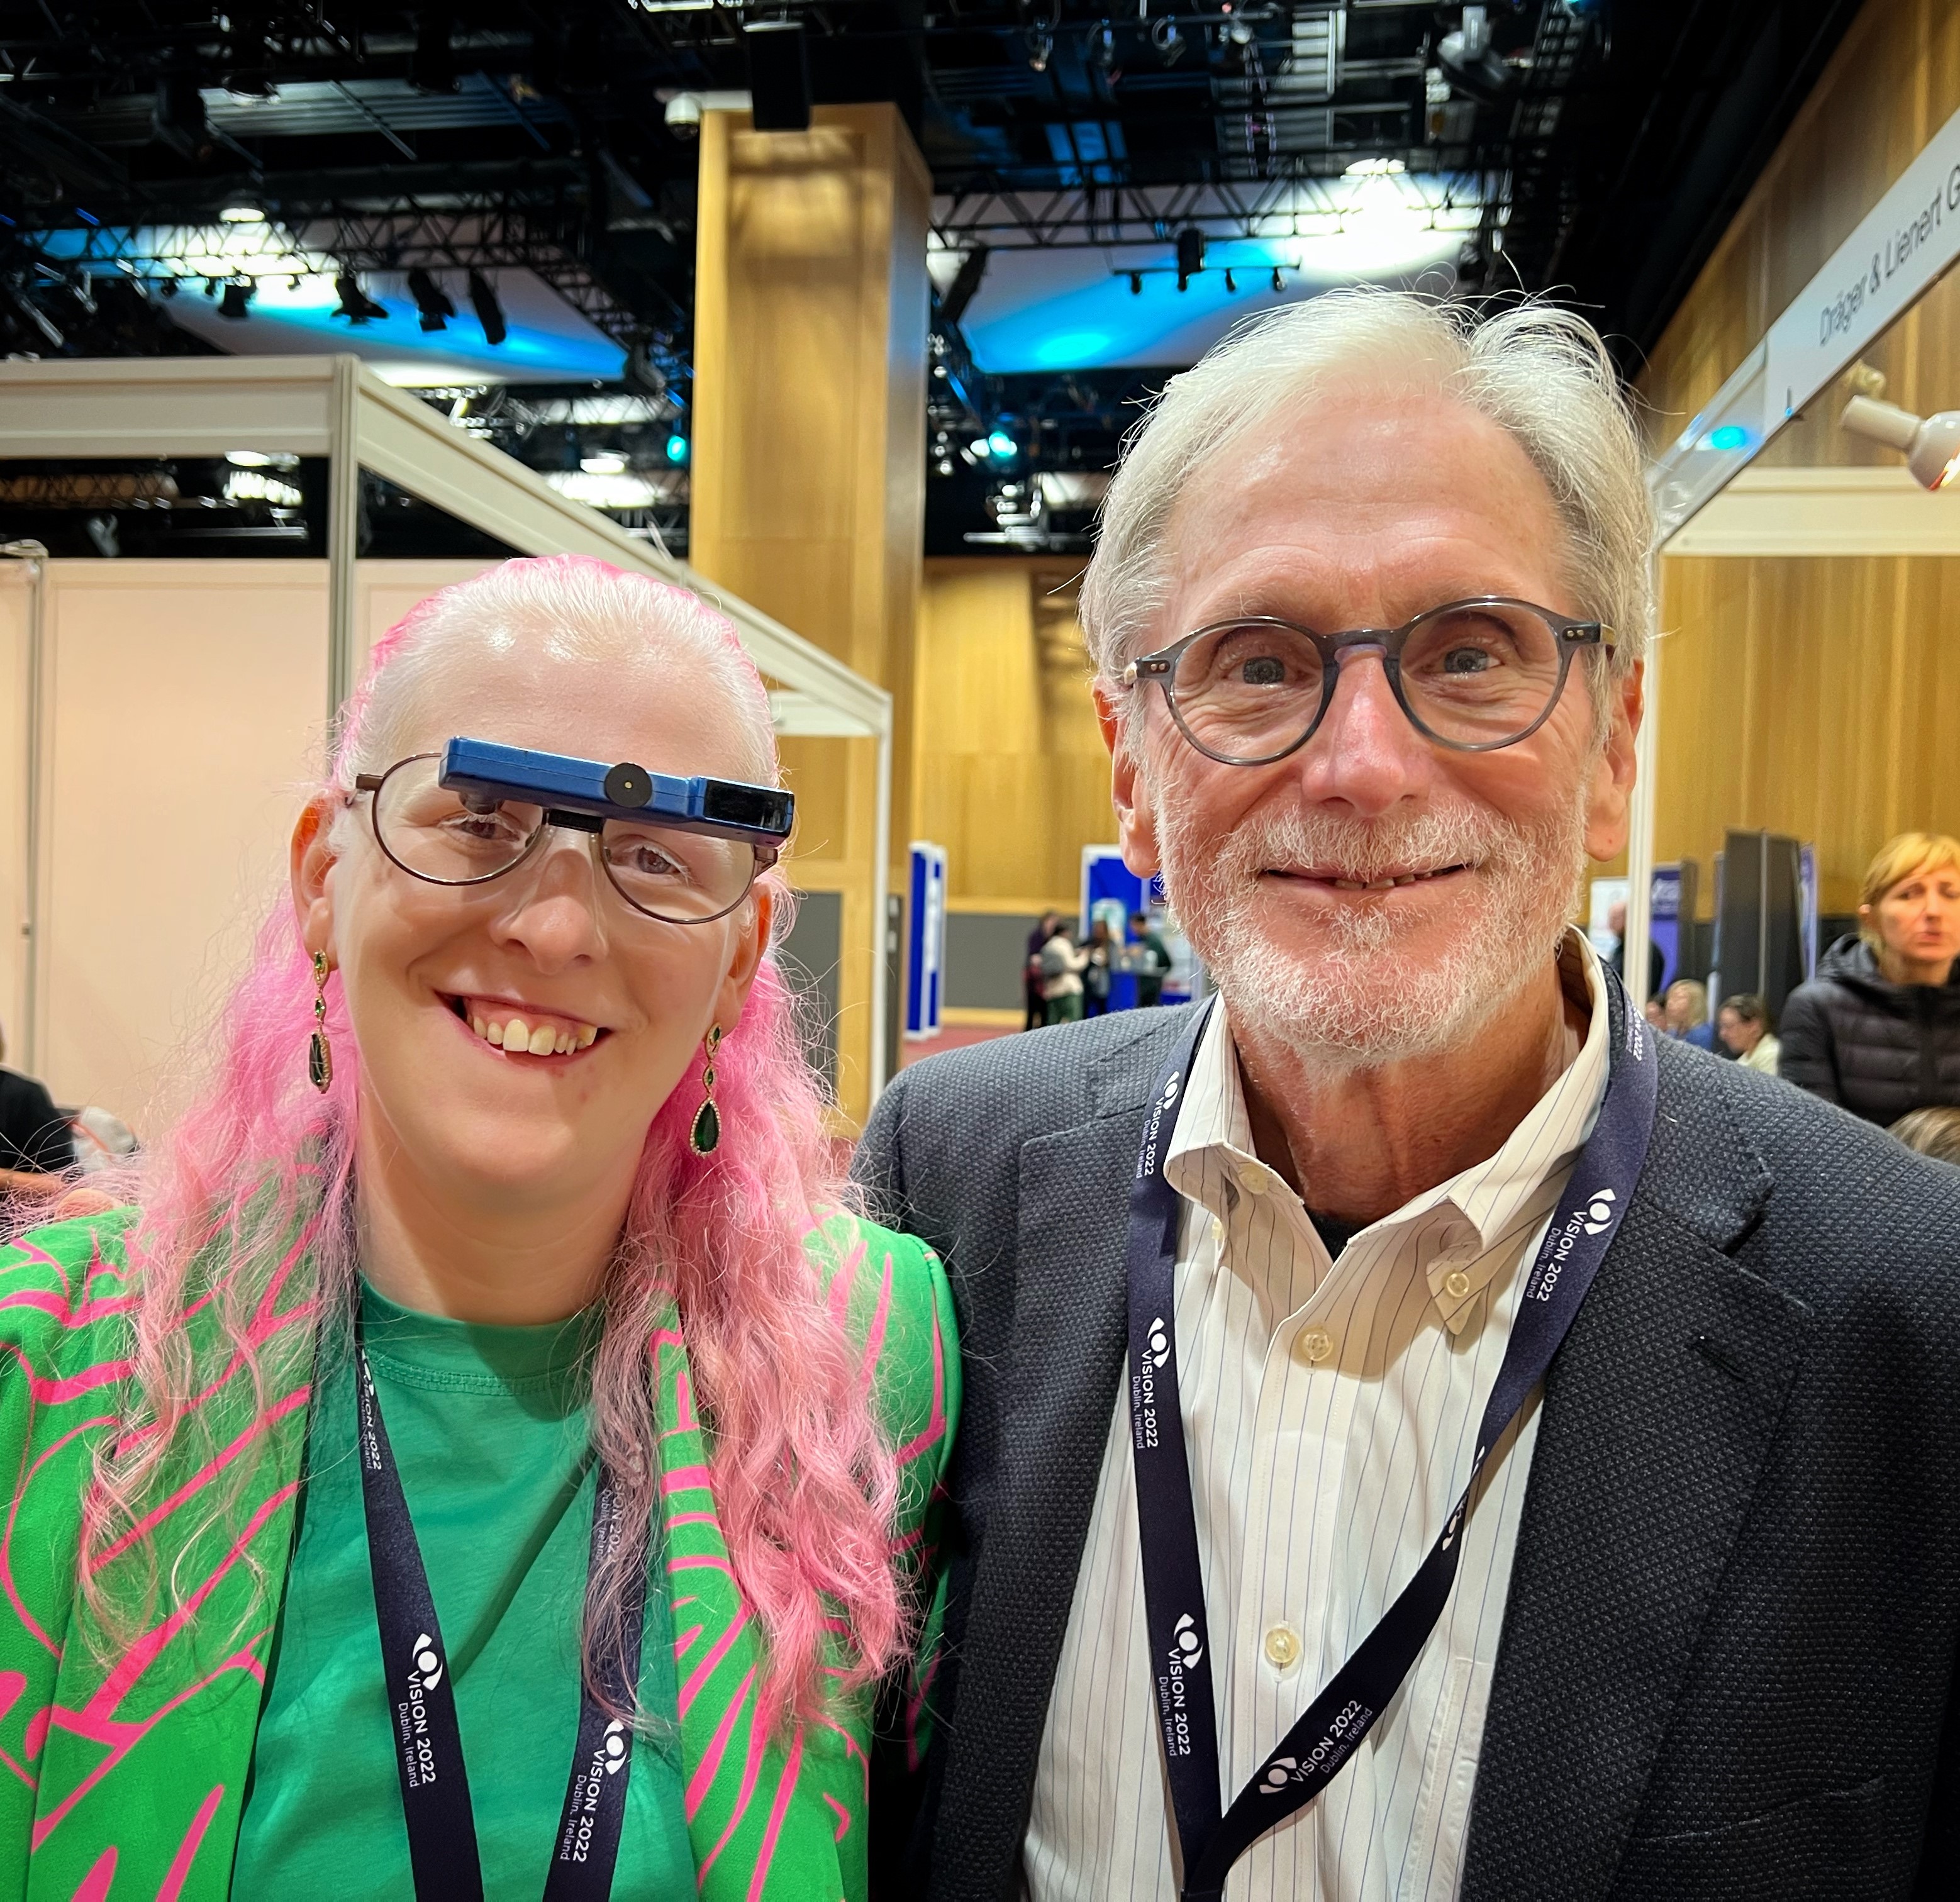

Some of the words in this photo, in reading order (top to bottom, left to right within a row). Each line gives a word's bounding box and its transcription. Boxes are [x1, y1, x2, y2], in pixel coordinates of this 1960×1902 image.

[1869, 252, 1881, 296] &
[1885, 186, 1942, 279] Lienert
[1149, 1097, 1165, 1140] VISION
[1136, 1150, 1145, 1179] Ireland
[1144, 1143, 1157, 1176] 2022
[1554, 1211, 1588, 1261] VISION
[1526, 1264, 1547, 1299] Ireland
[1536, 1262, 1562, 1302] 2022
[1141, 1349, 1154, 1404] VISION
[1134, 1413, 1145, 1449] Ireland
[1144, 1408, 1159, 1448] 2022
[368, 1431, 382, 1470] 2022
[1168, 1647, 1186, 1707] VISION
[408, 1670, 428, 1733] VISION
[1164, 1718, 1178, 1756] Ireland
[1174, 1713, 1191, 1755] 2022
[1290, 1736, 1334, 1782] VISION
[1329, 1700, 1362, 1737] 2022
[1344, 1707, 1373, 1742] Ireland
[404, 1746, 420, 1788] Ireland
[416, 1738, 437, 1784] 2022
[584, 1749, 606, 1811] VISION
[560, 1819, 578, 1860] Ireland
[572, 1816, 594, 1862] 2022
